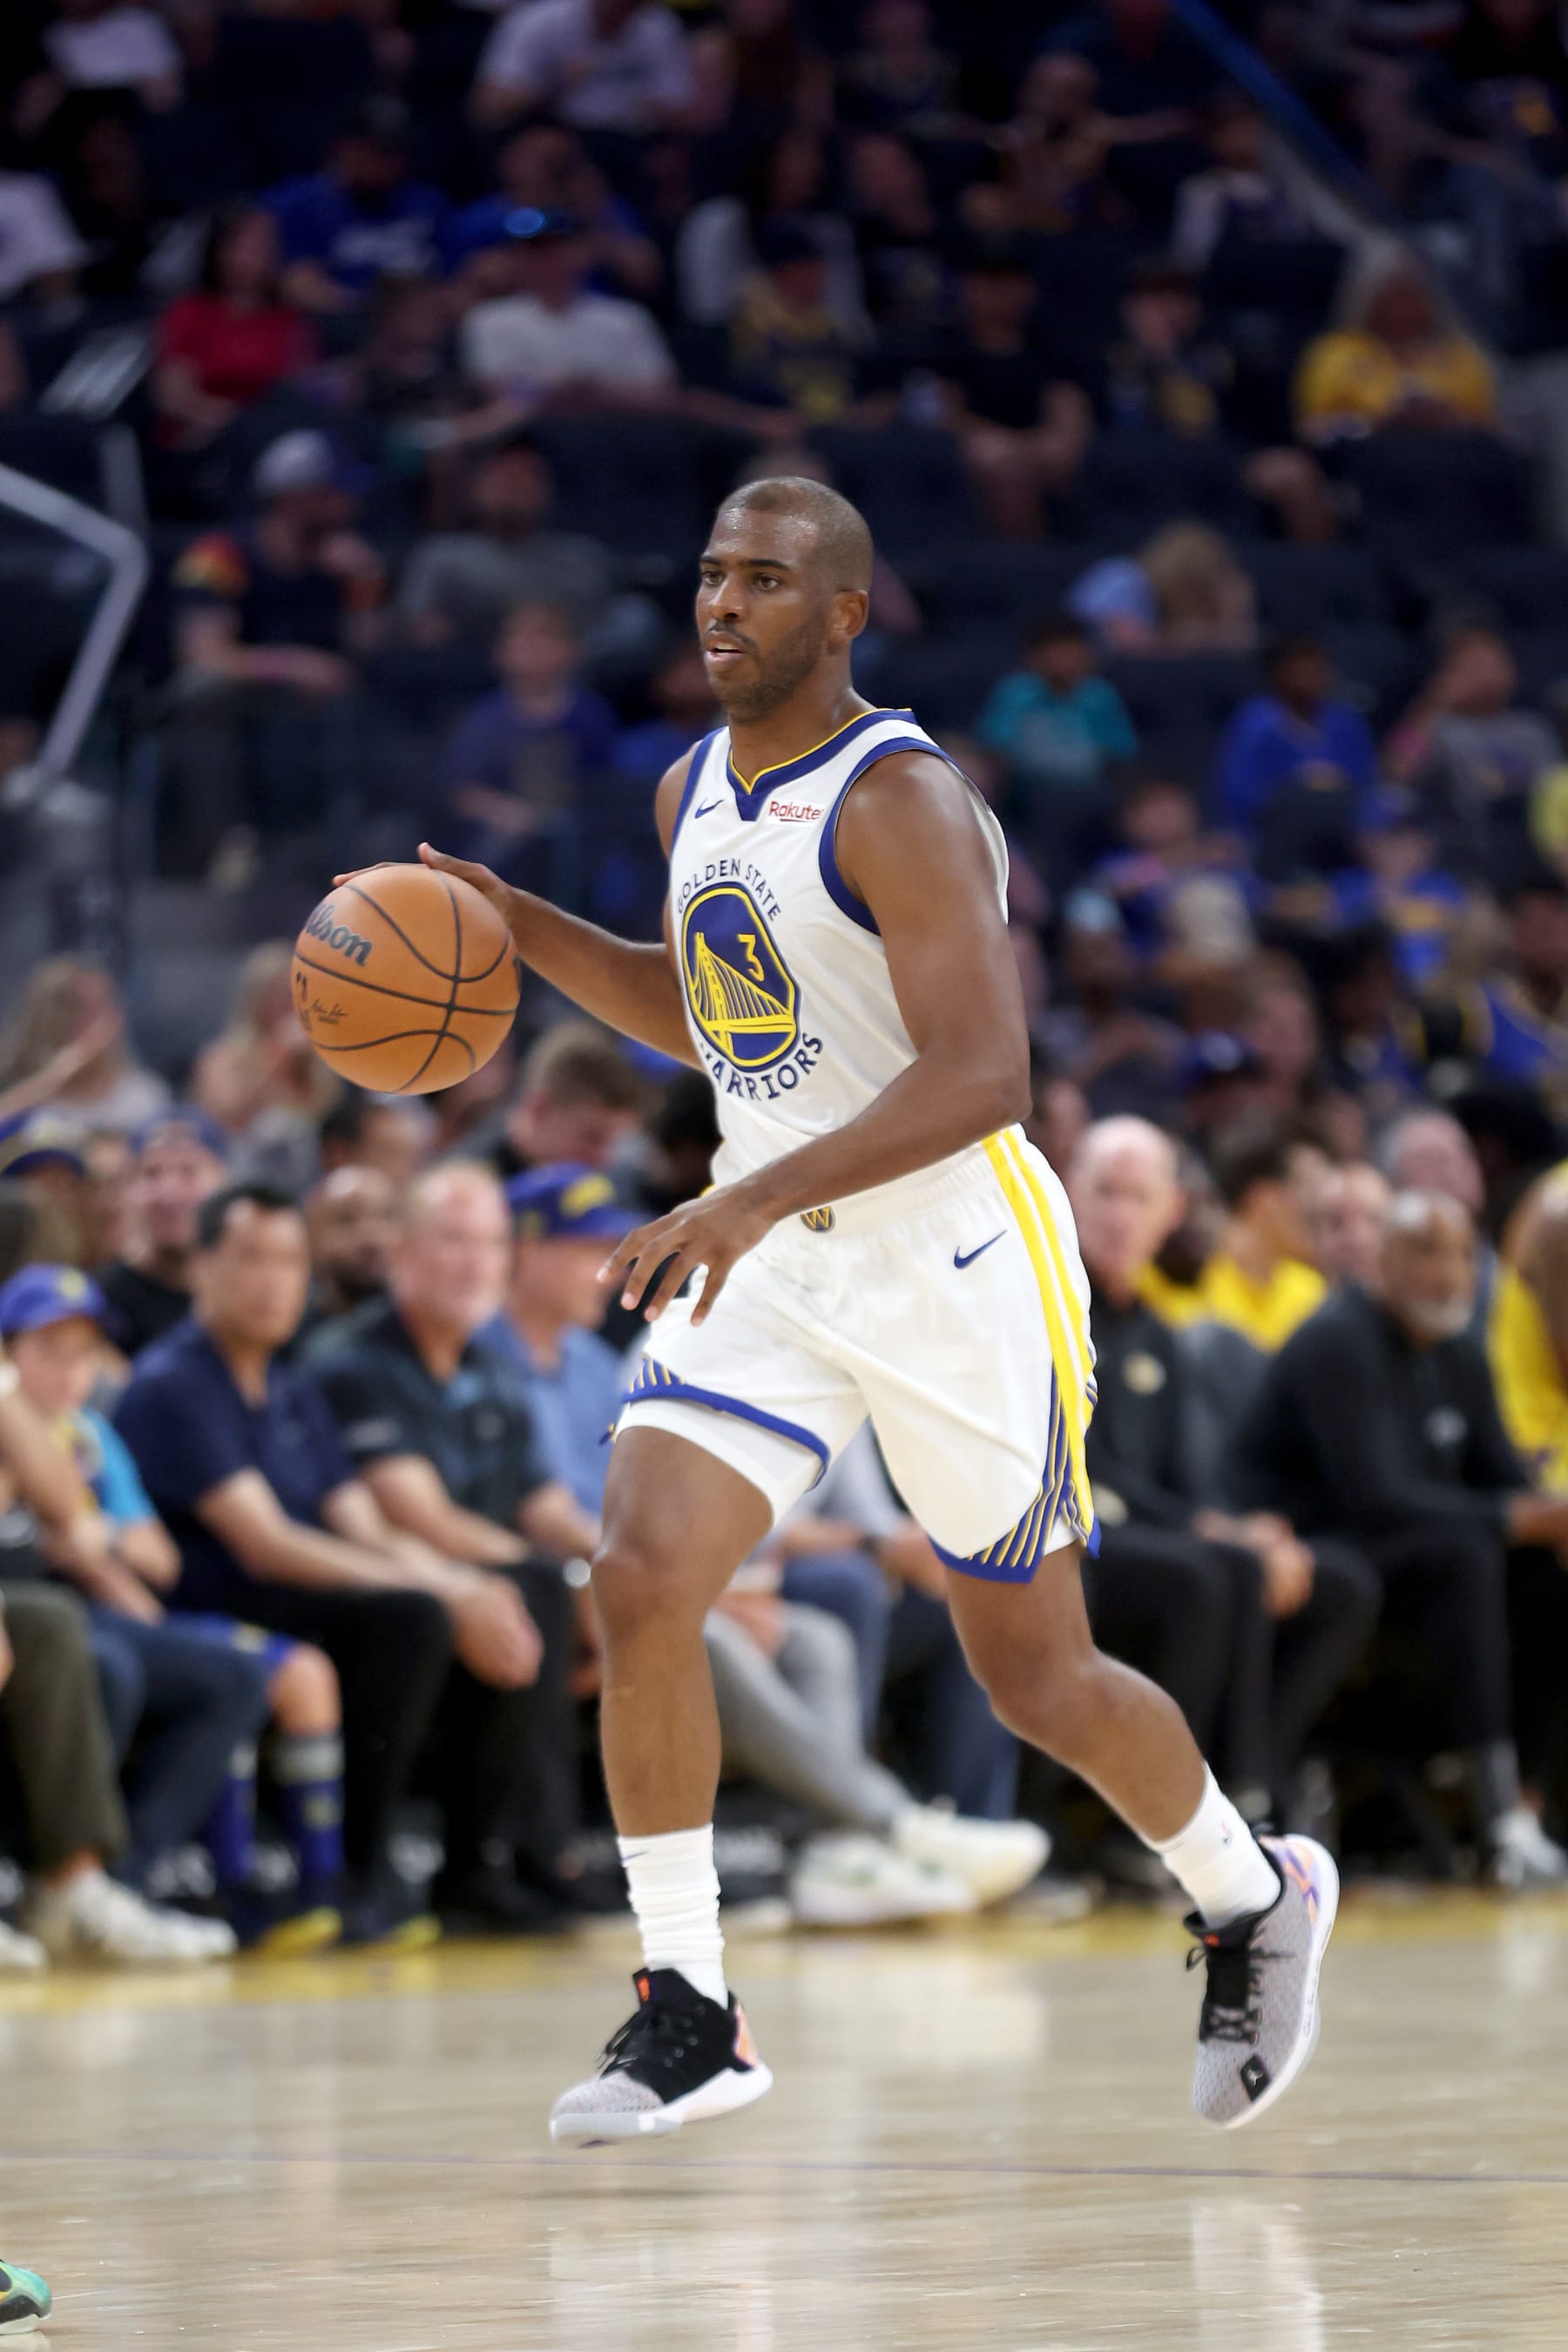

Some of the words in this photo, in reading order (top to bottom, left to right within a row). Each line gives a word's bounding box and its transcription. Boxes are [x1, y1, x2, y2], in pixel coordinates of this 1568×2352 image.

[768, 801, 824, 822] Rakute
[678, 857, 741, 914] GOLDEN
[745, 863, 781, 922] STATE
[737, 933, 765, 982] 3
